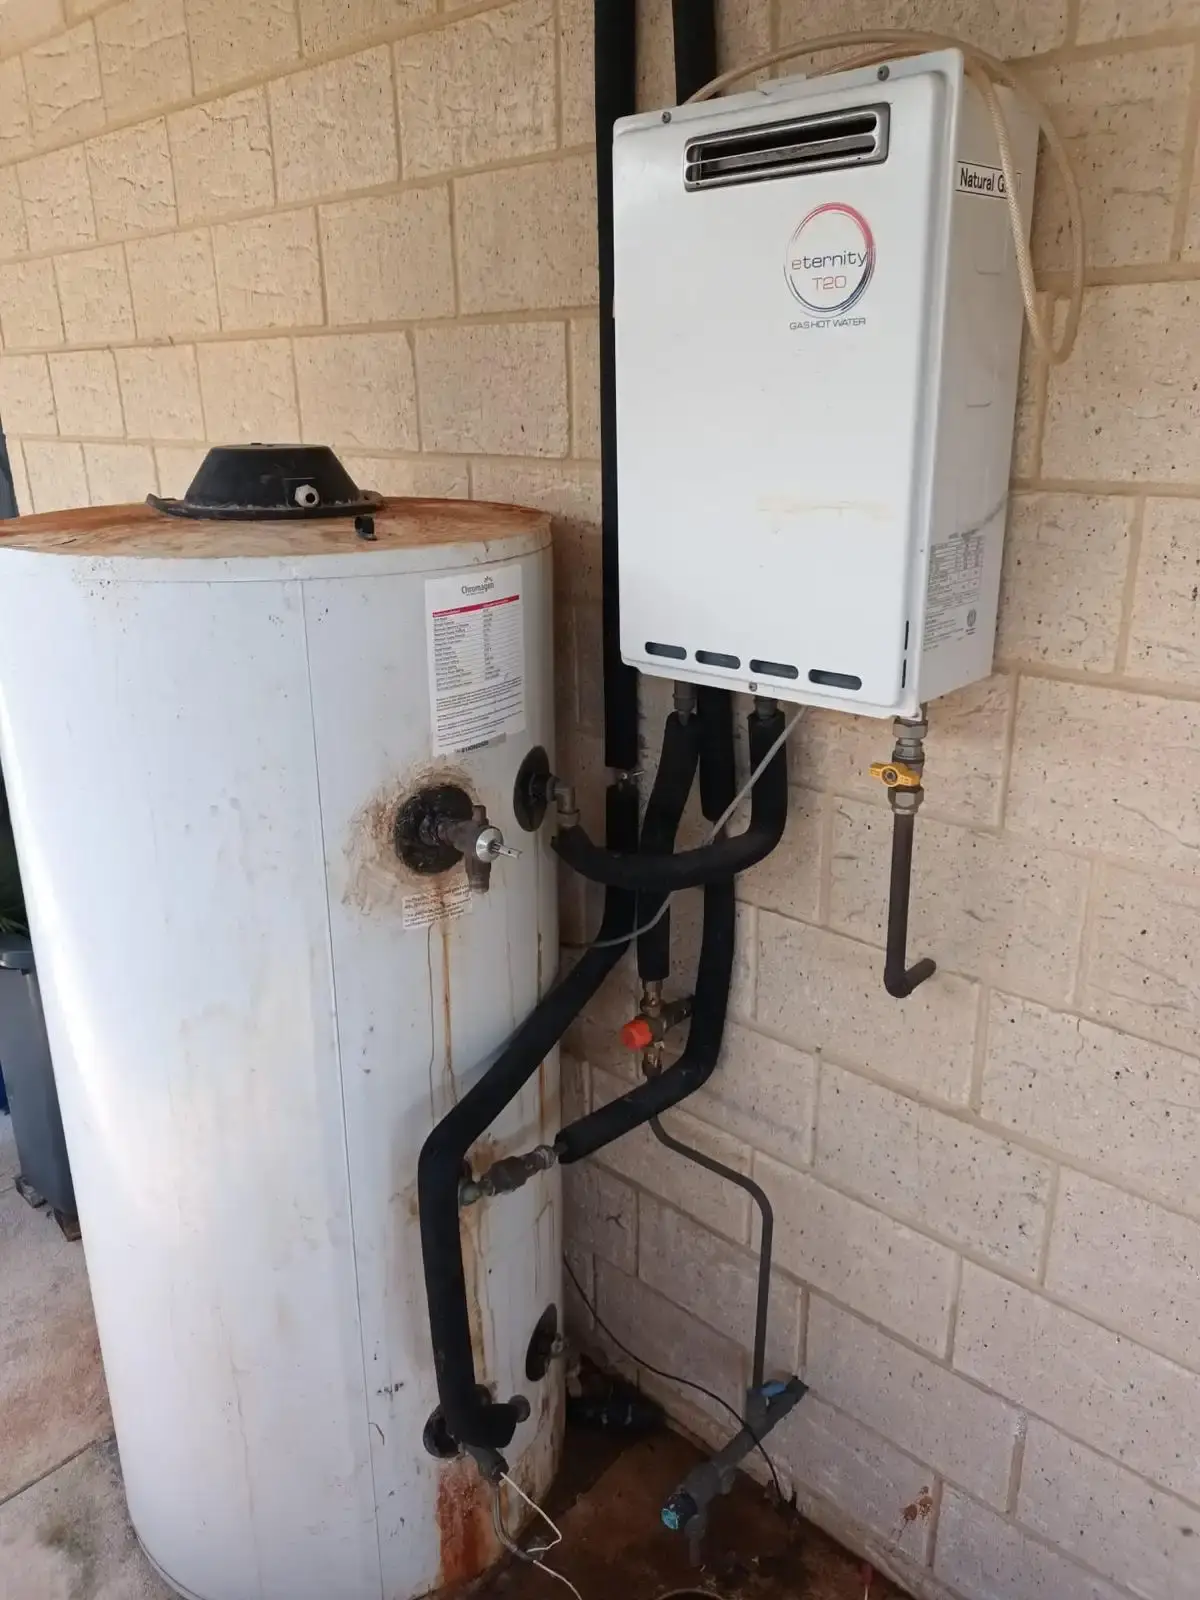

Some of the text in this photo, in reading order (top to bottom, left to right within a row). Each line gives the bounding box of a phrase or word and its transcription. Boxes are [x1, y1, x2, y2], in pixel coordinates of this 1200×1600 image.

[960, 167, 994, 191] Natural
[792, 250, 868, 270] eternity
[812, 275, 847, 290] T20
[832, 317, 867, 328] WATER
